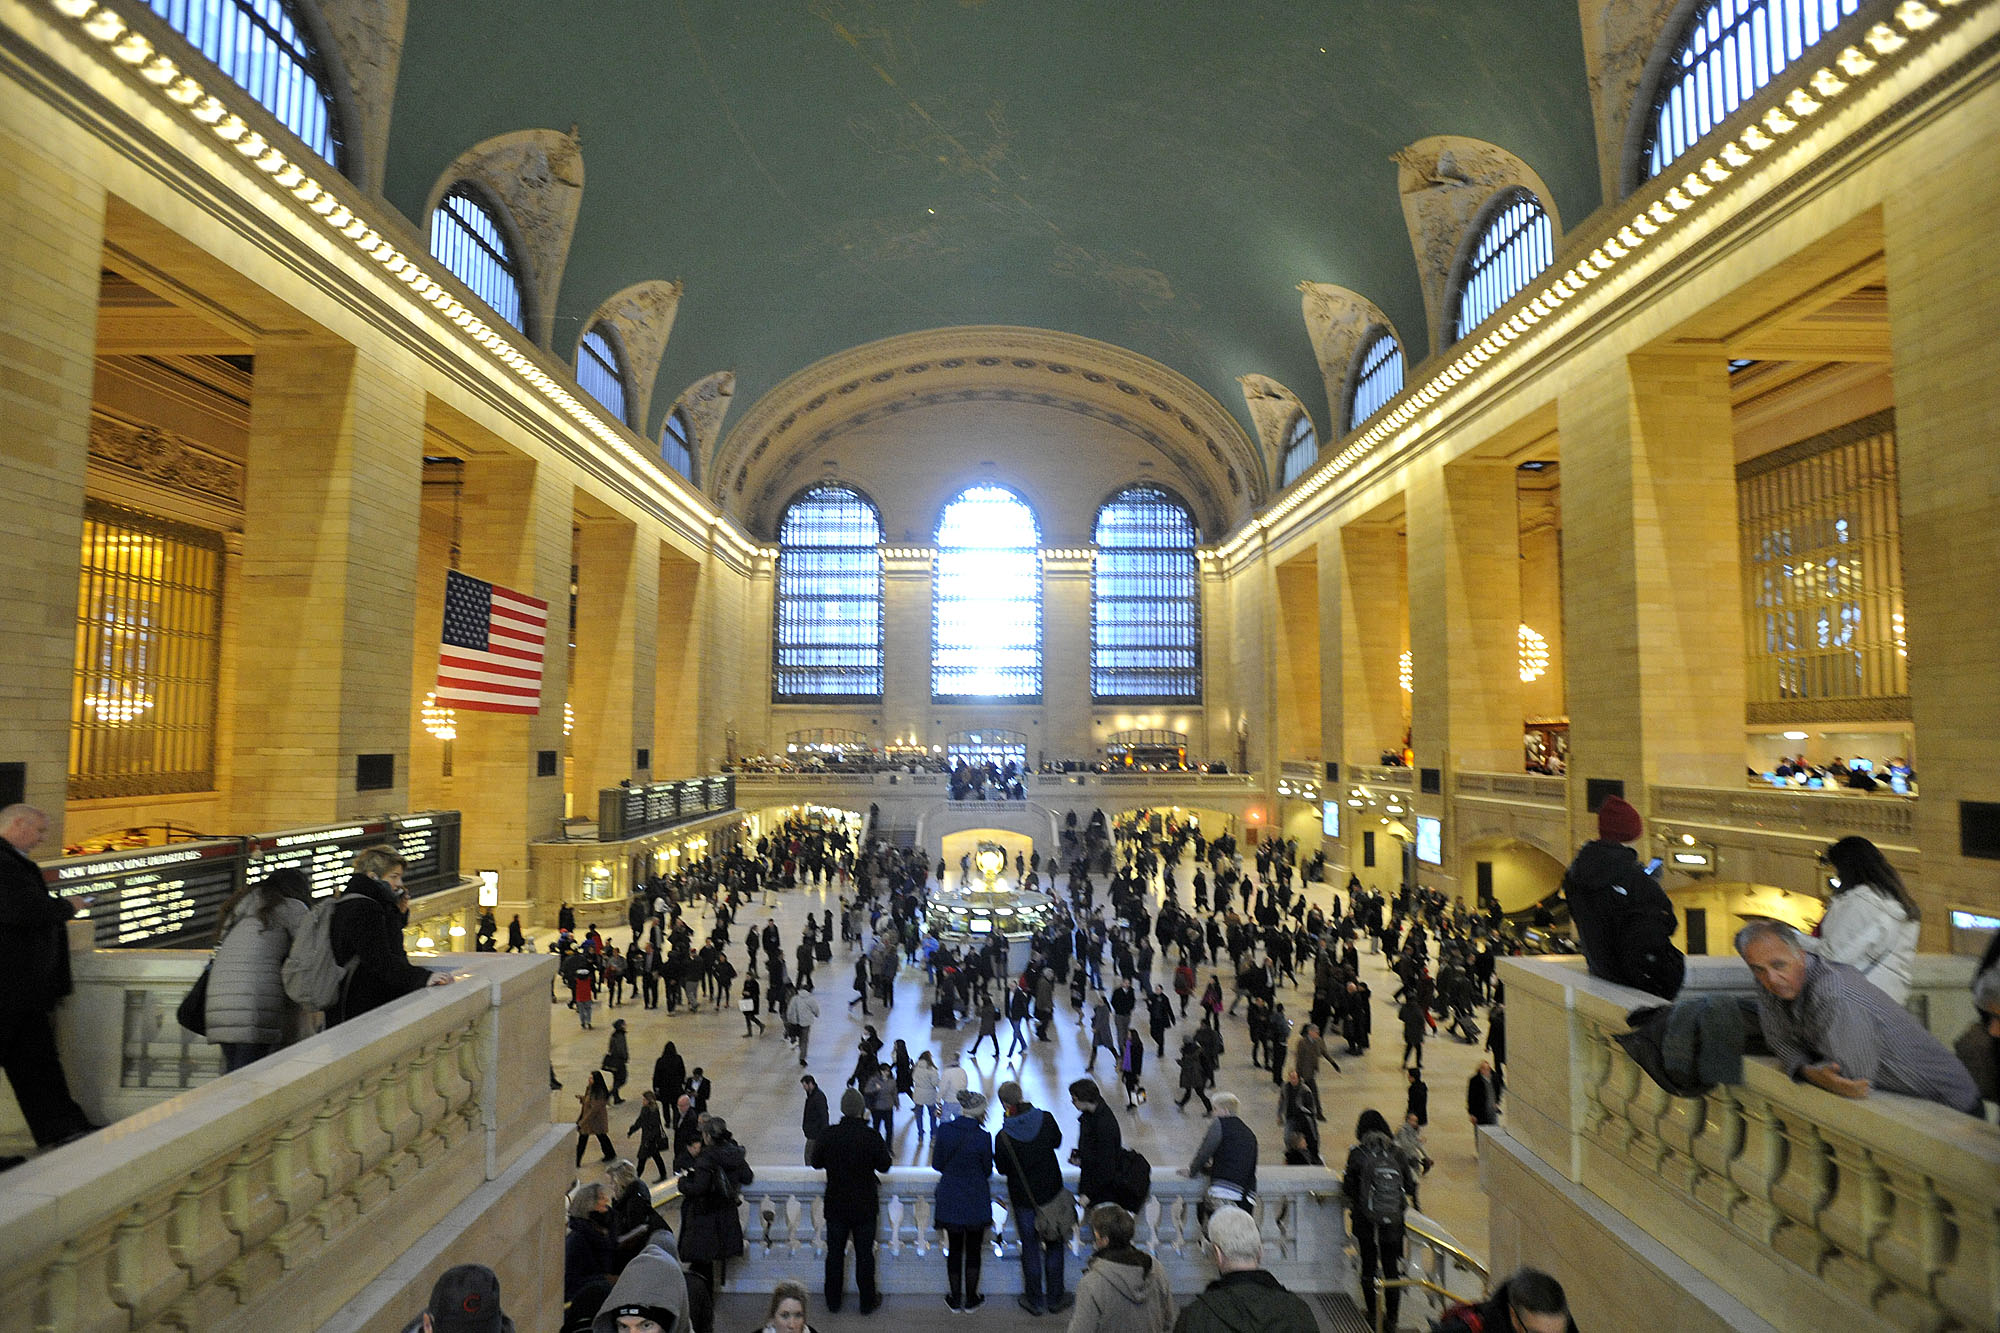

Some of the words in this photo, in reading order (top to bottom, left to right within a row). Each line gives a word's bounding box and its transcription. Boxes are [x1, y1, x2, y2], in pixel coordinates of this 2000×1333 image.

[58, 866, 86, 880] NEW
[87, 859, 125, 876] HAVEN
[124, 856, 149, 869] LINE
[147, 850, 203, 866] DEPARTURES
